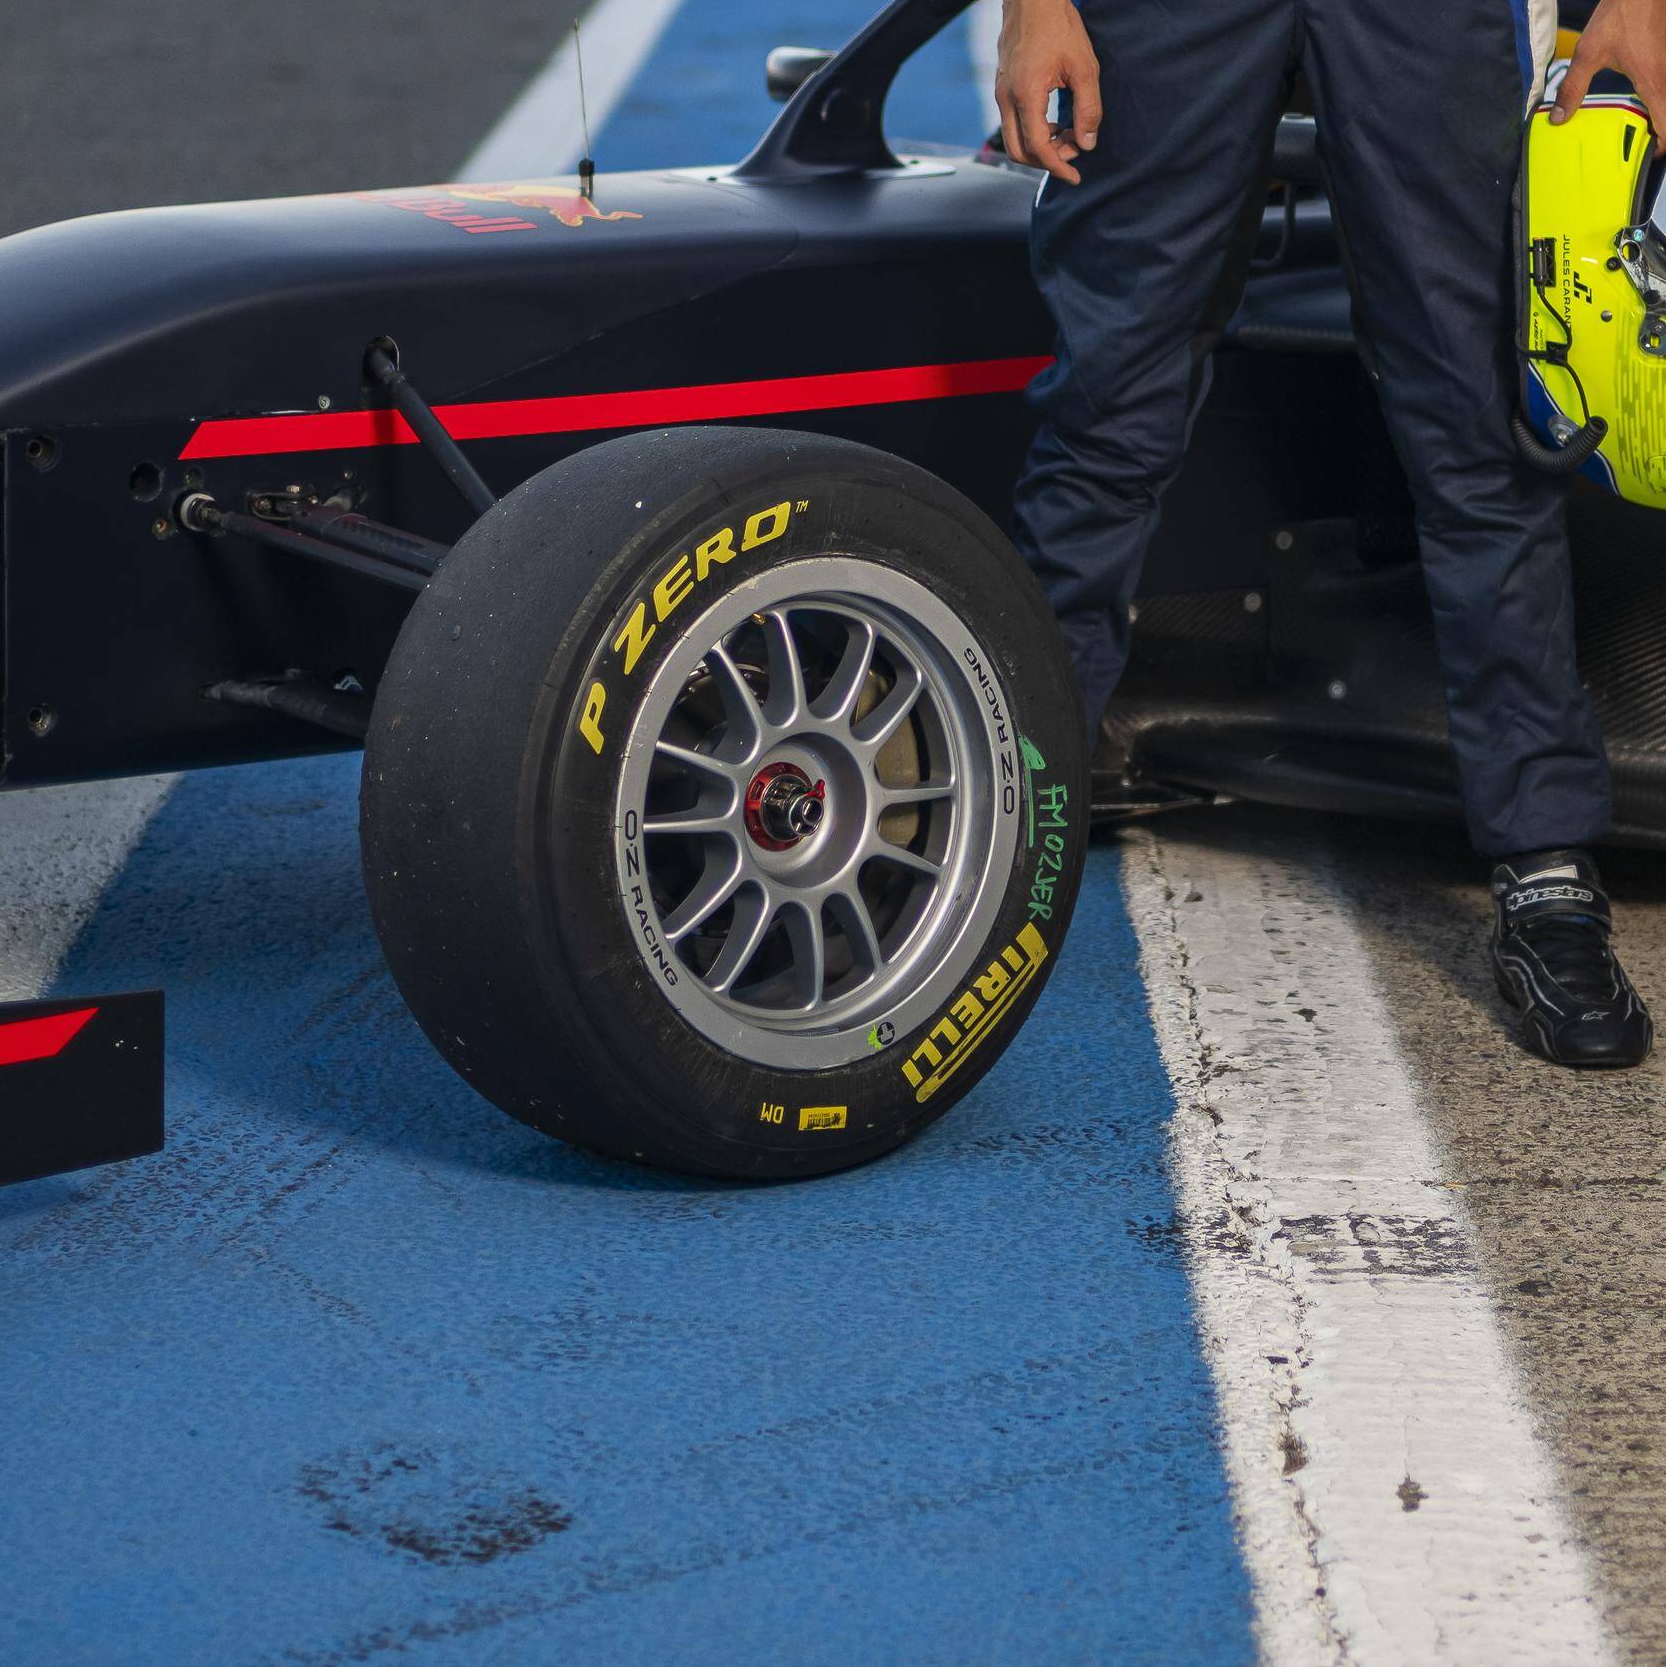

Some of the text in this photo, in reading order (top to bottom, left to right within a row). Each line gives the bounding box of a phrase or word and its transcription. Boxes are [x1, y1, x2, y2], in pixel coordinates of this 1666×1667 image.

[1563, 234, 1572, 327] JULES CARAN
[580, 682, 607, 754] P
[614, 501, 791, 675] ZERO
[963, 647, 1009, 744] RACING
[631, 885, 679, 987] RACING
[1506, 885, 1593, 911] alpinestars
[901, 922, 1049, 1103] PIRELLI
